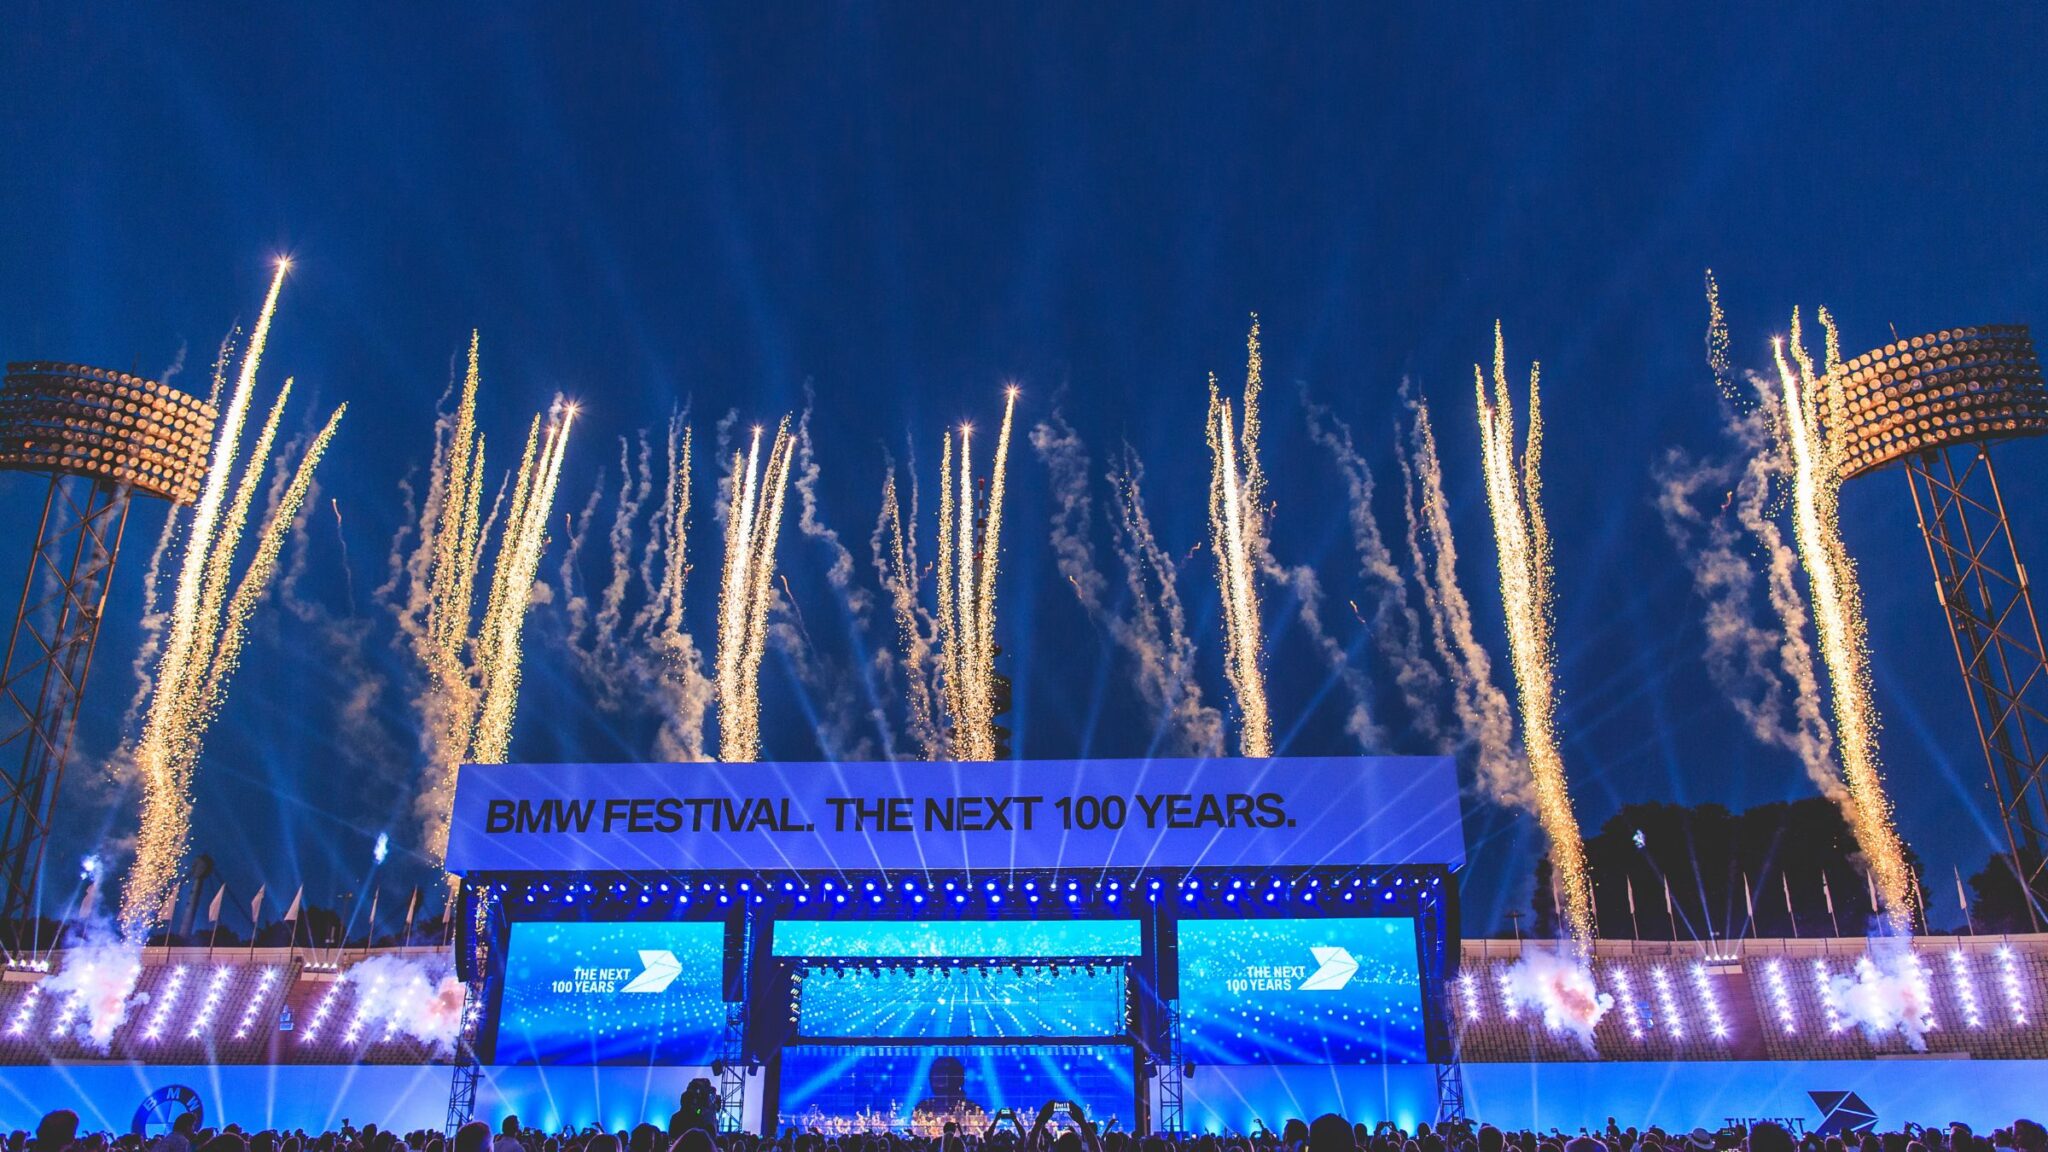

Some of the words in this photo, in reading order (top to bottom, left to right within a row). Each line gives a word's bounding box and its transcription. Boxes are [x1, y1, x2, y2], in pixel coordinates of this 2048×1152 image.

[486, 799, 595, 833] BMW
[602, 798, 815, 833] FESTIVAL.
[826, 797, 914, 832] THE
[924, 796, 1043, 832] NEXT
[1054, 795, 1127, 830] 100
[1135, 793, 1297, 829] YEARS.
[573, 968, 597, 981] THE
[599, 968, 631, 981] NEXT
[1246, 965, 1271, 978] THE
[1273, 965, 1306, 978] NEXT
[551, 981, 573, 993] 100
[574, 981, 615, 993] YEARS
[1226, 979, 1248, 992] 100
[1249, 979, 1292, 991] YEARS
[143, 1087, 200, 1112] BMW
[1762, 1118, 1805, 1135] XT
